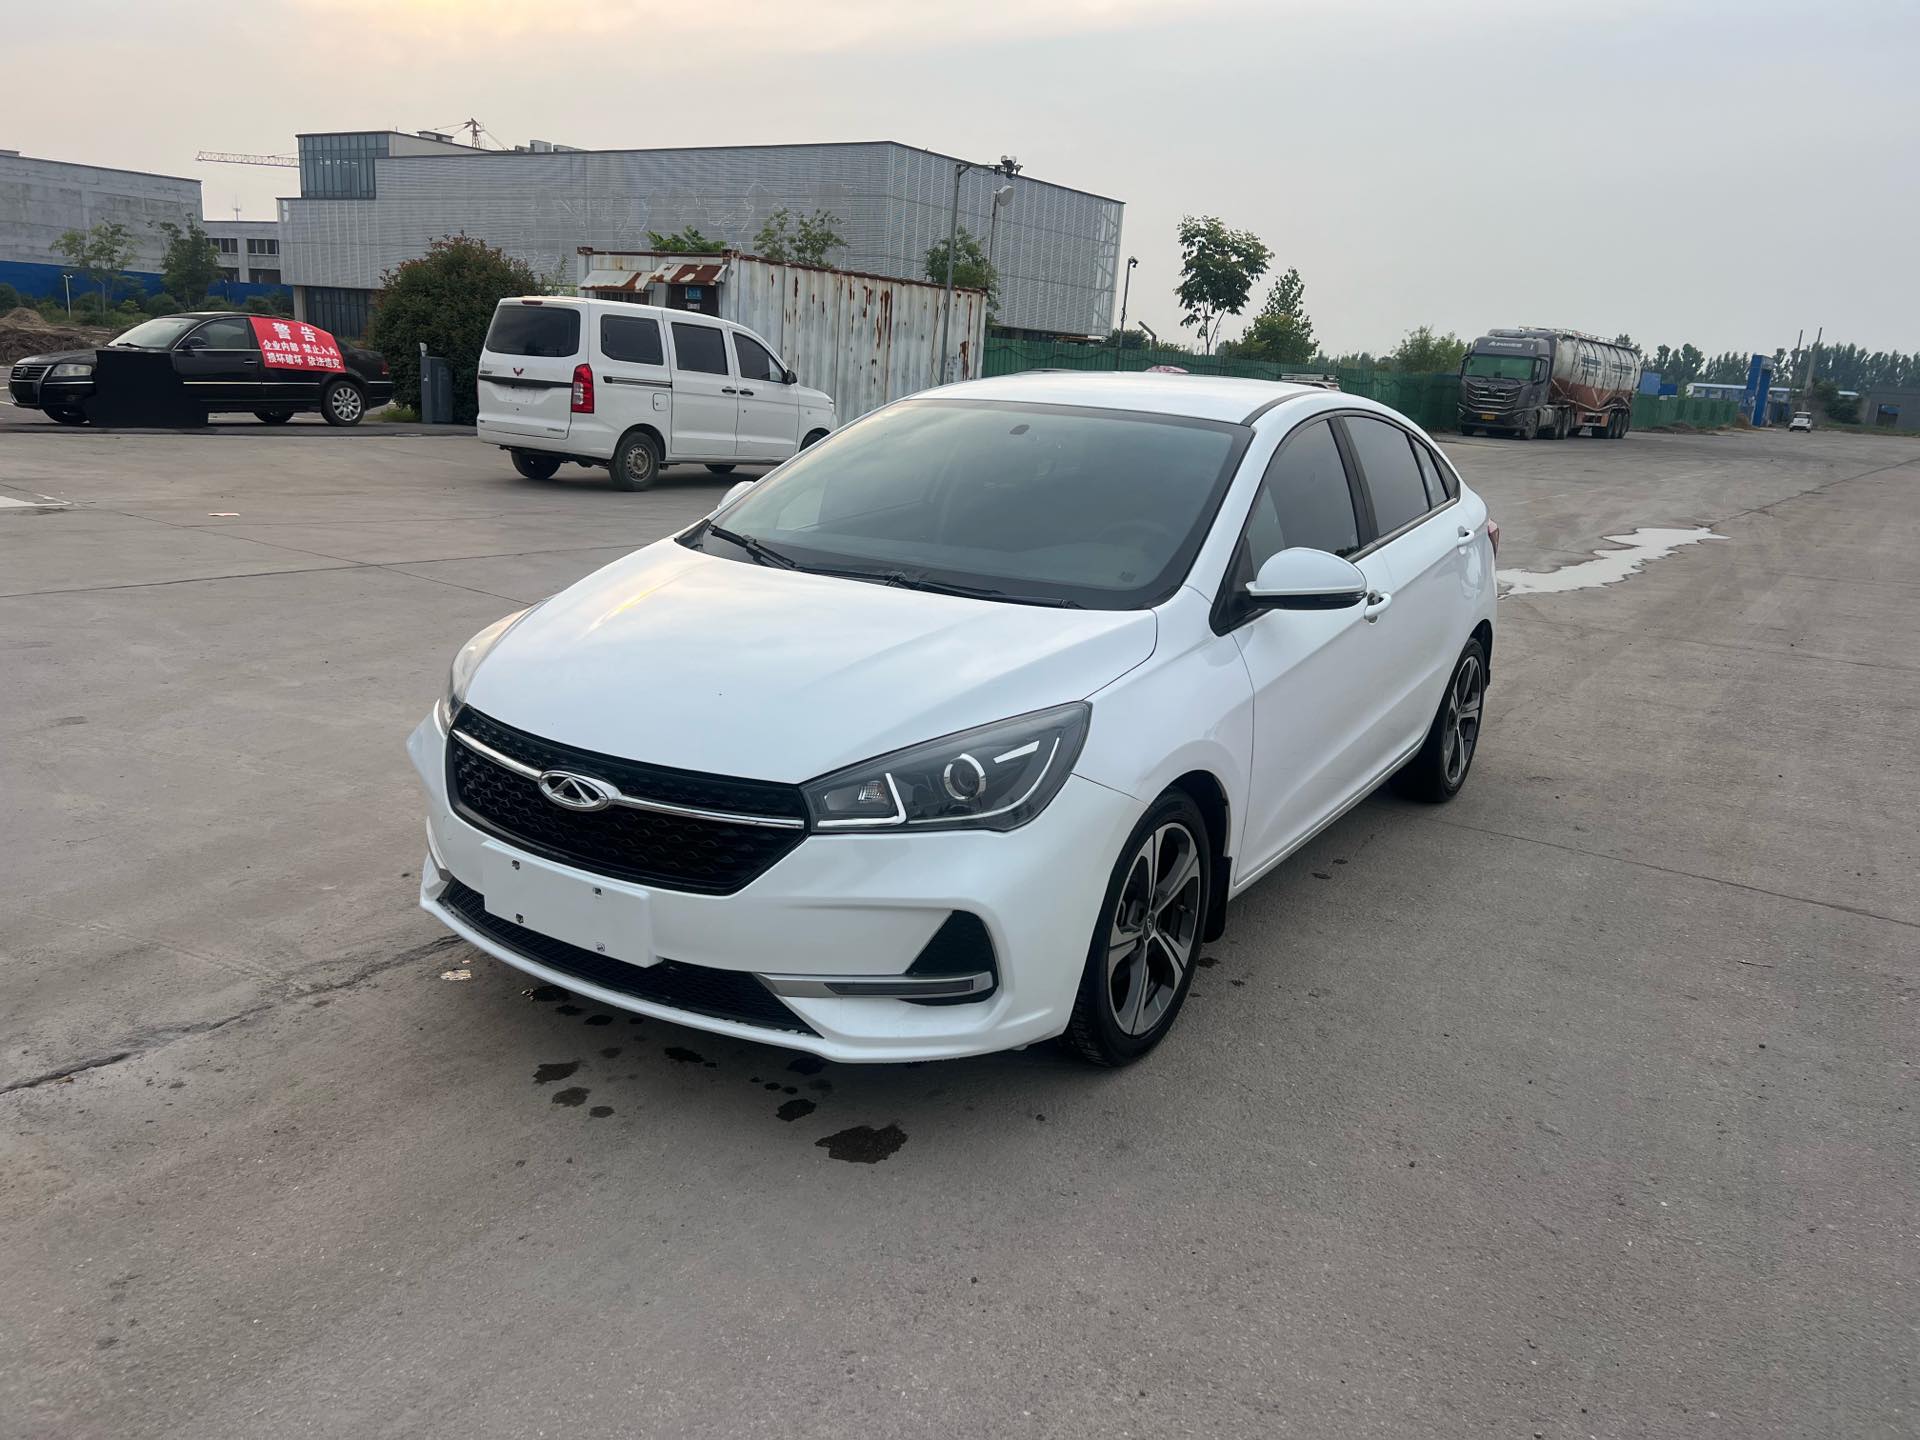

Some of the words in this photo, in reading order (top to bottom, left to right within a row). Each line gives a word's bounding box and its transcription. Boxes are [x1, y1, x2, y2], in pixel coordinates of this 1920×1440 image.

[272, 322, 316, 342] 警告
[263, 339, 299, 352] 企业内部
